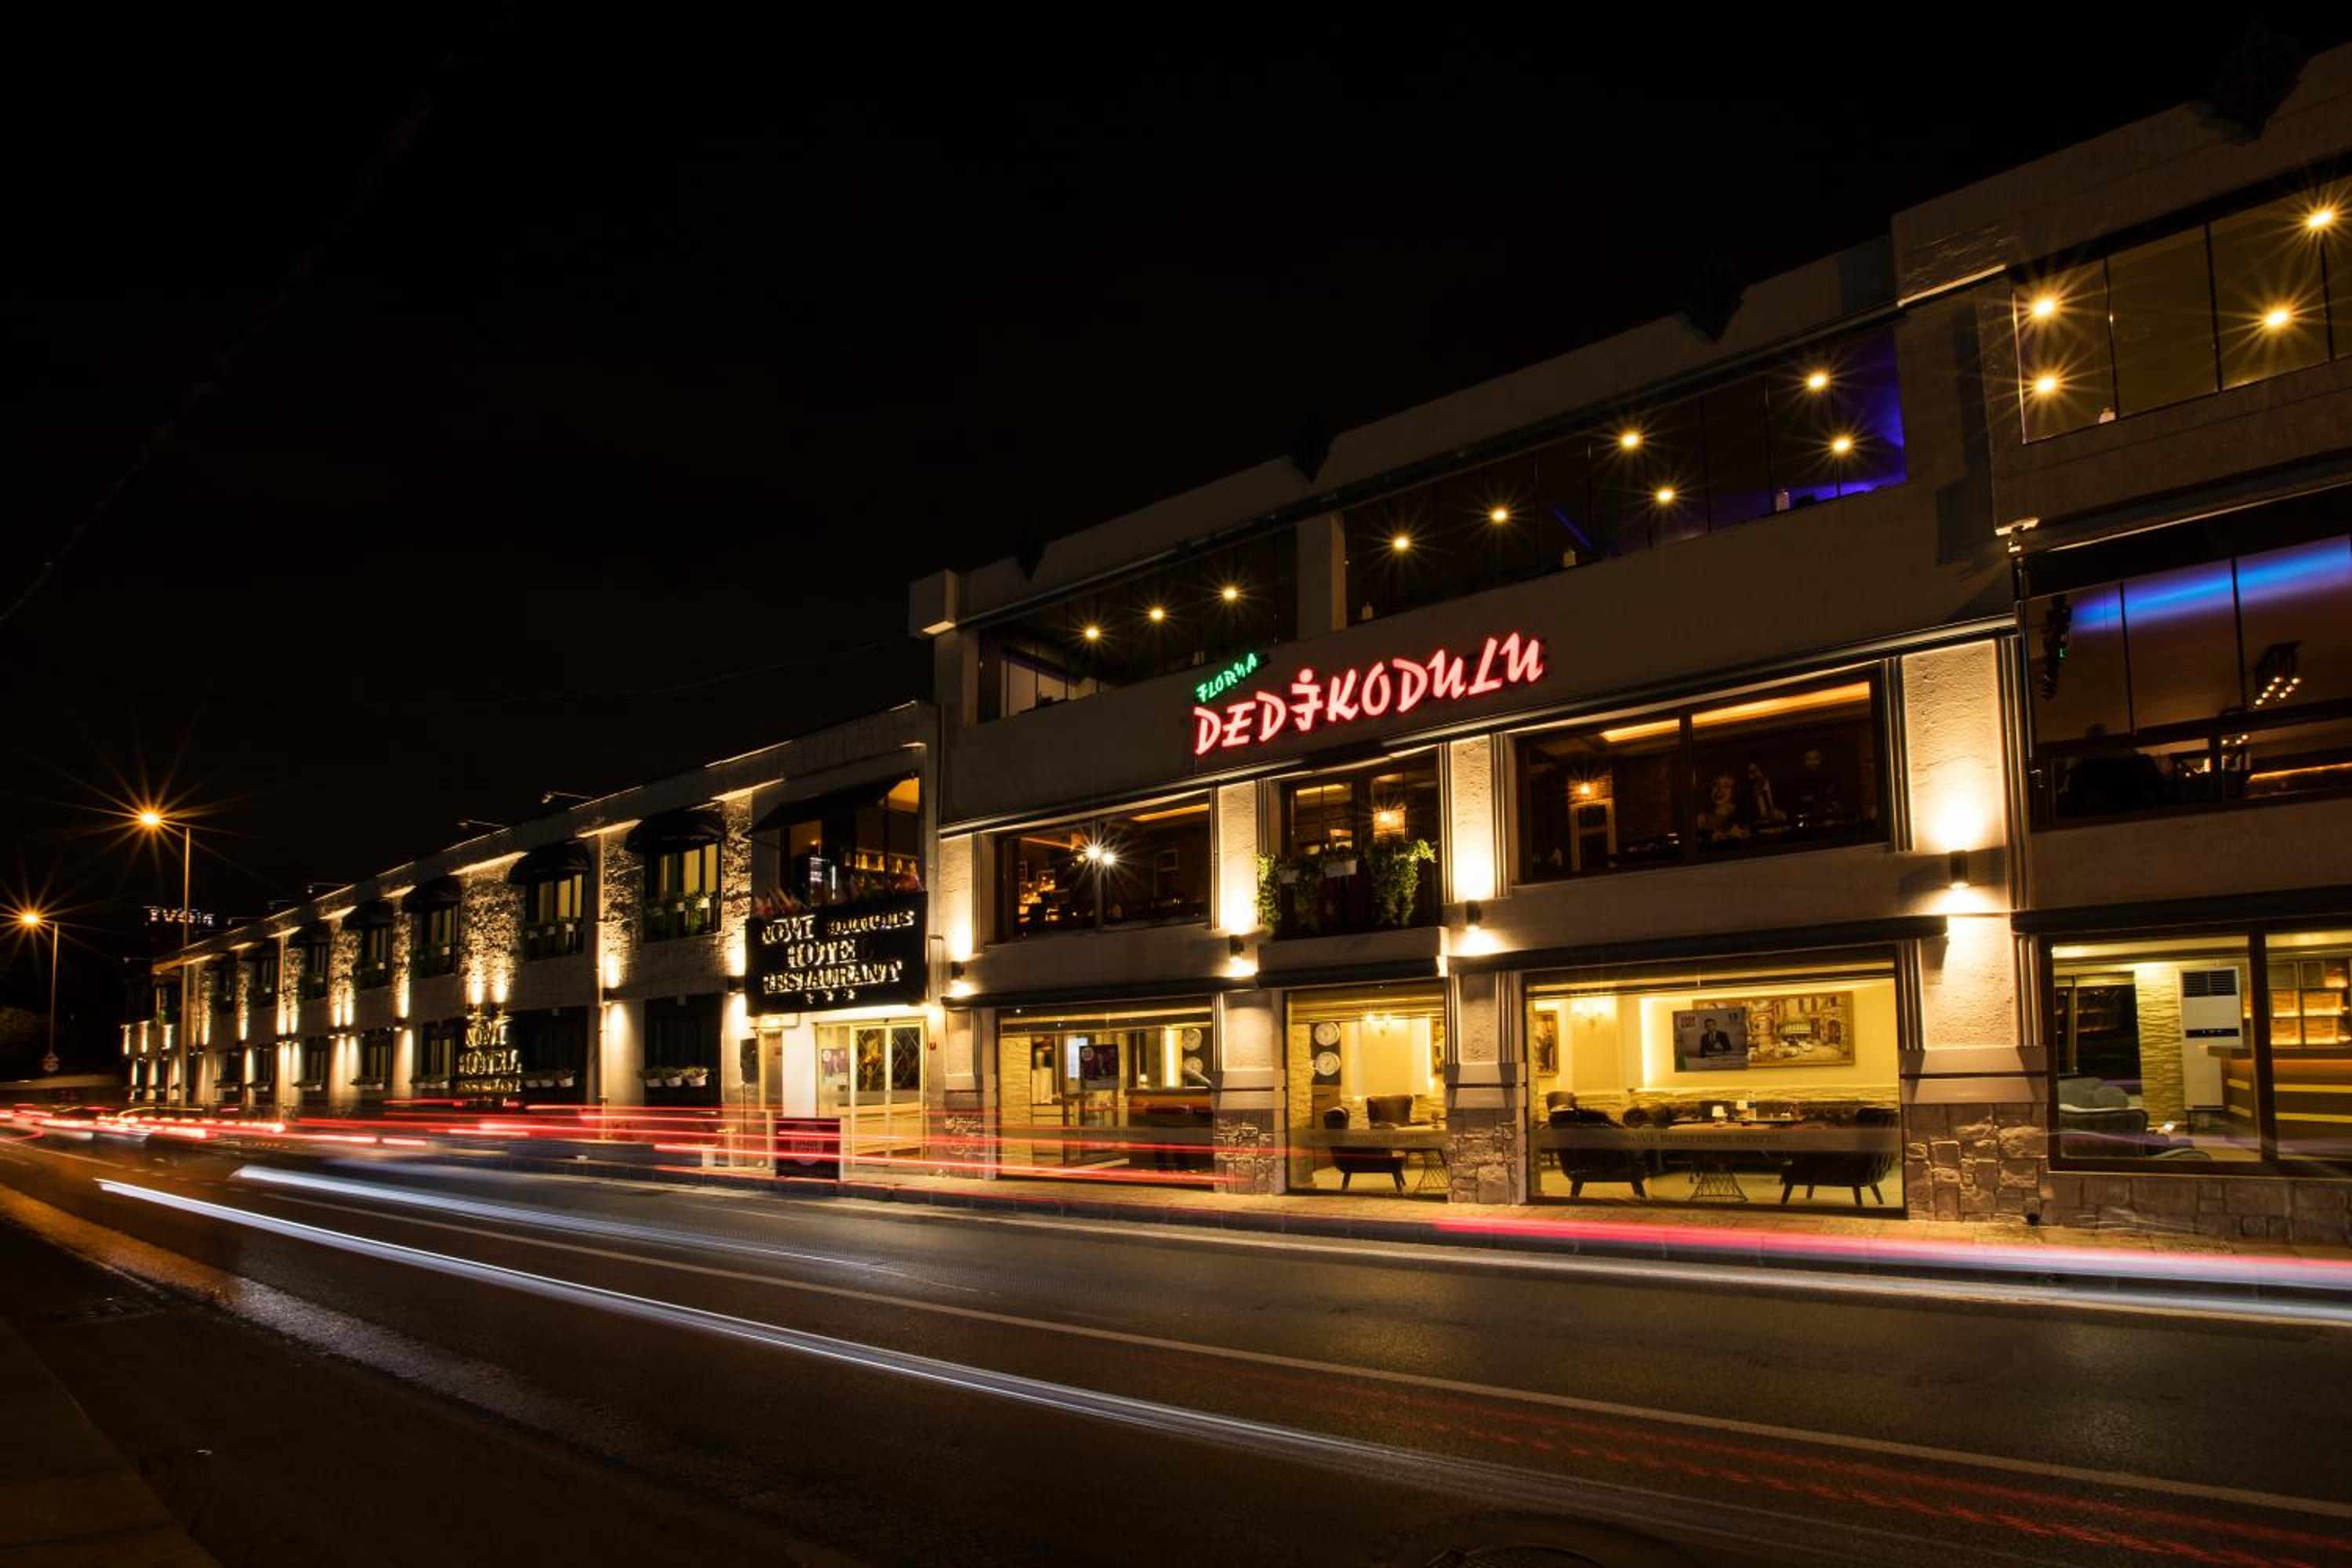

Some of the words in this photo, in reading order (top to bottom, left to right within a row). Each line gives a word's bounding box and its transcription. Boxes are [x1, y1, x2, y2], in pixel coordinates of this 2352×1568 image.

[1192, 631, 1545, 757] DEDİKODULU
[1195, 652, 1259, 704] FLORYA
[763, 960, 902, 995] RESTAURANT
[458, 1049, 522, 1075] HOTEL
